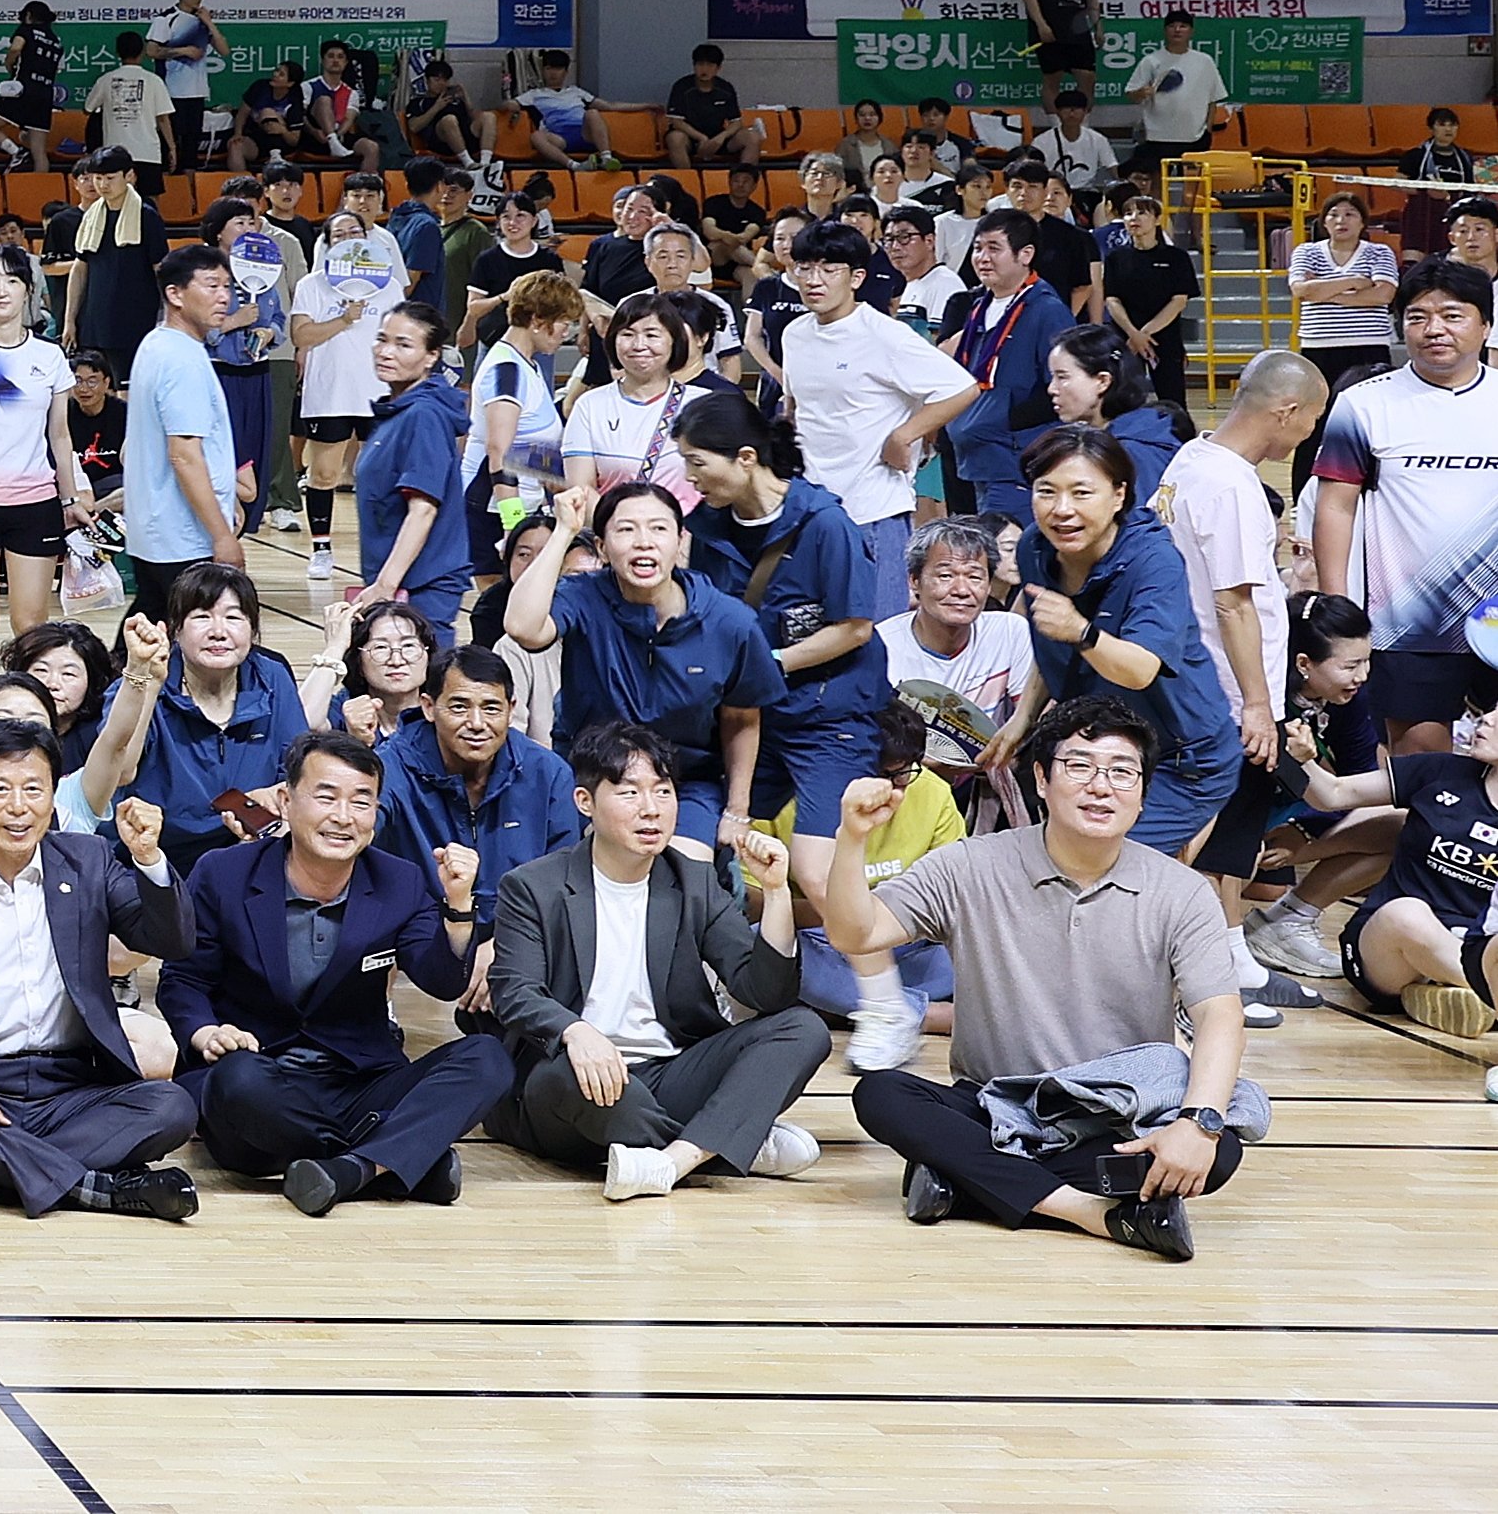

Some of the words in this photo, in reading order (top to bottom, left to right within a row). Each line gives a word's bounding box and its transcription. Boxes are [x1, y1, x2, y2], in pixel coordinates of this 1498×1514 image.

[298, 7, 333, 19] 유아연
[386, 7, 405, 19] 2위
[514, 3, 557, 19] 화순군
[1299, 183, 1308, 204] 9
[1430, 835, 1472, 866] KB
